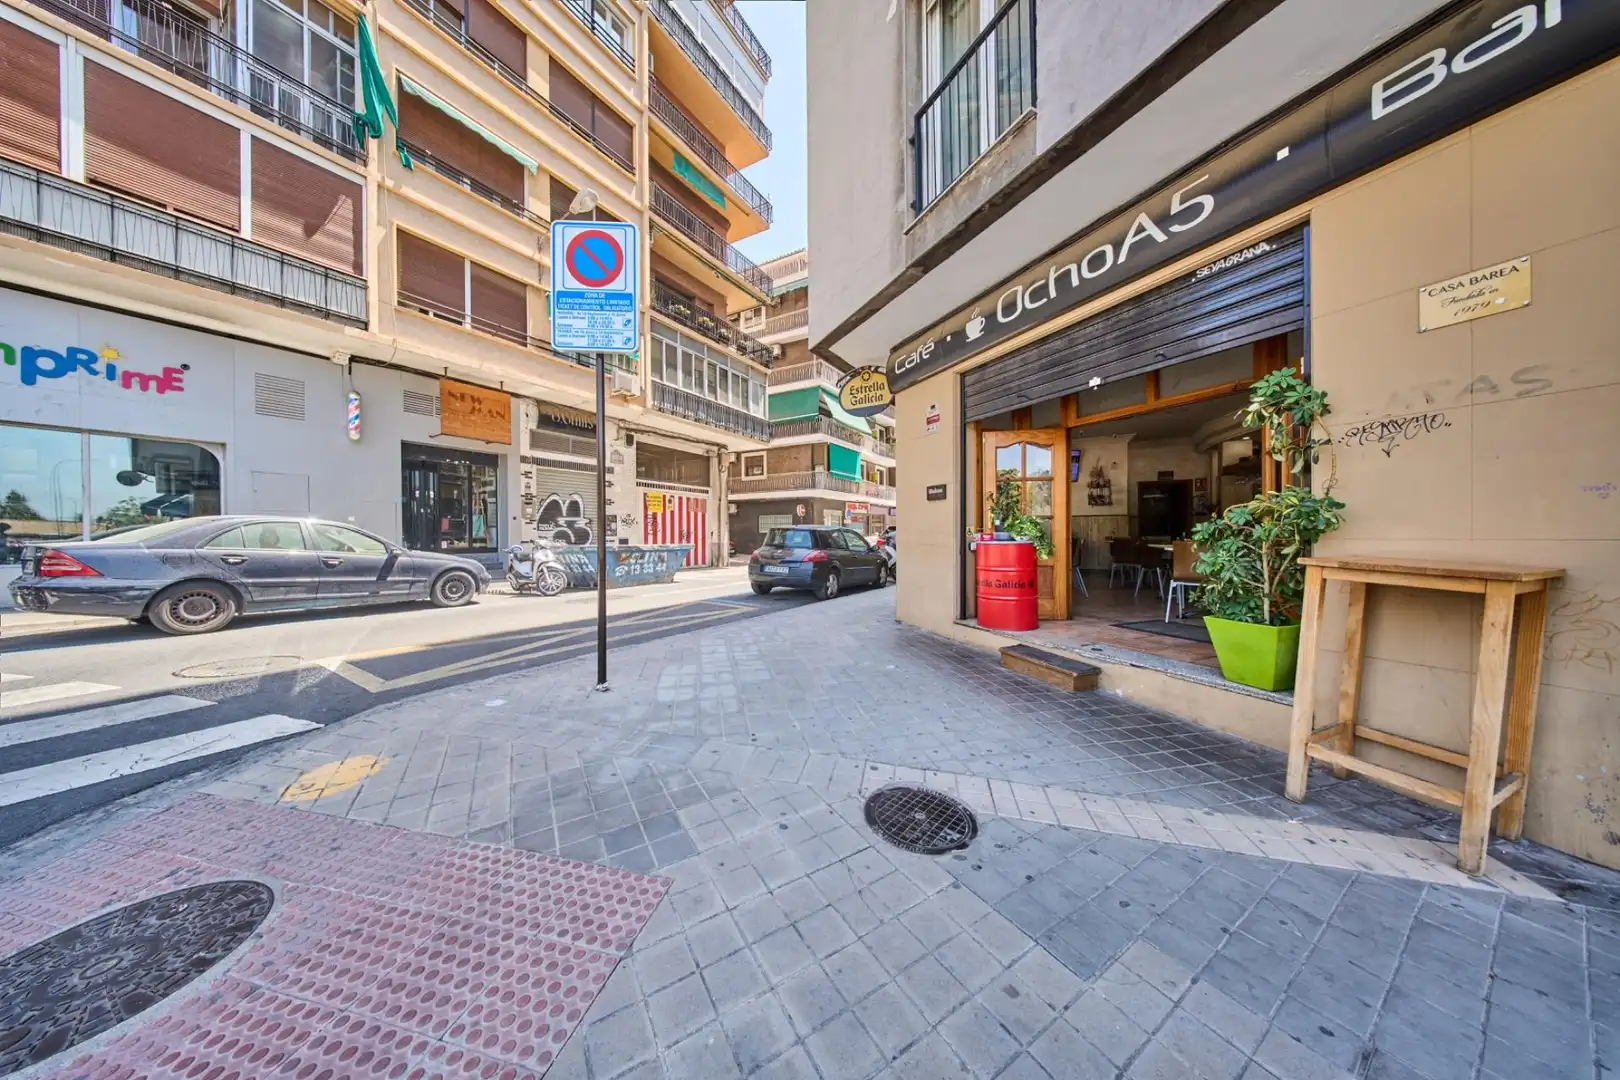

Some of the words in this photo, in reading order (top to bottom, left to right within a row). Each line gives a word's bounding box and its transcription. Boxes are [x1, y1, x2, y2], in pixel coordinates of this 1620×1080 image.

[1427, 281, 1465, 298] CASA
[1469, 264, 1520, 286] BAREA
[1453, 300, 1492, 317] 1979
[895, 337, 935, 375] Café
[849, 380, 886, 396] Estrella
[850, 393, 884, 406] Galicia
[994, 578, 1026, 589] Galicia
